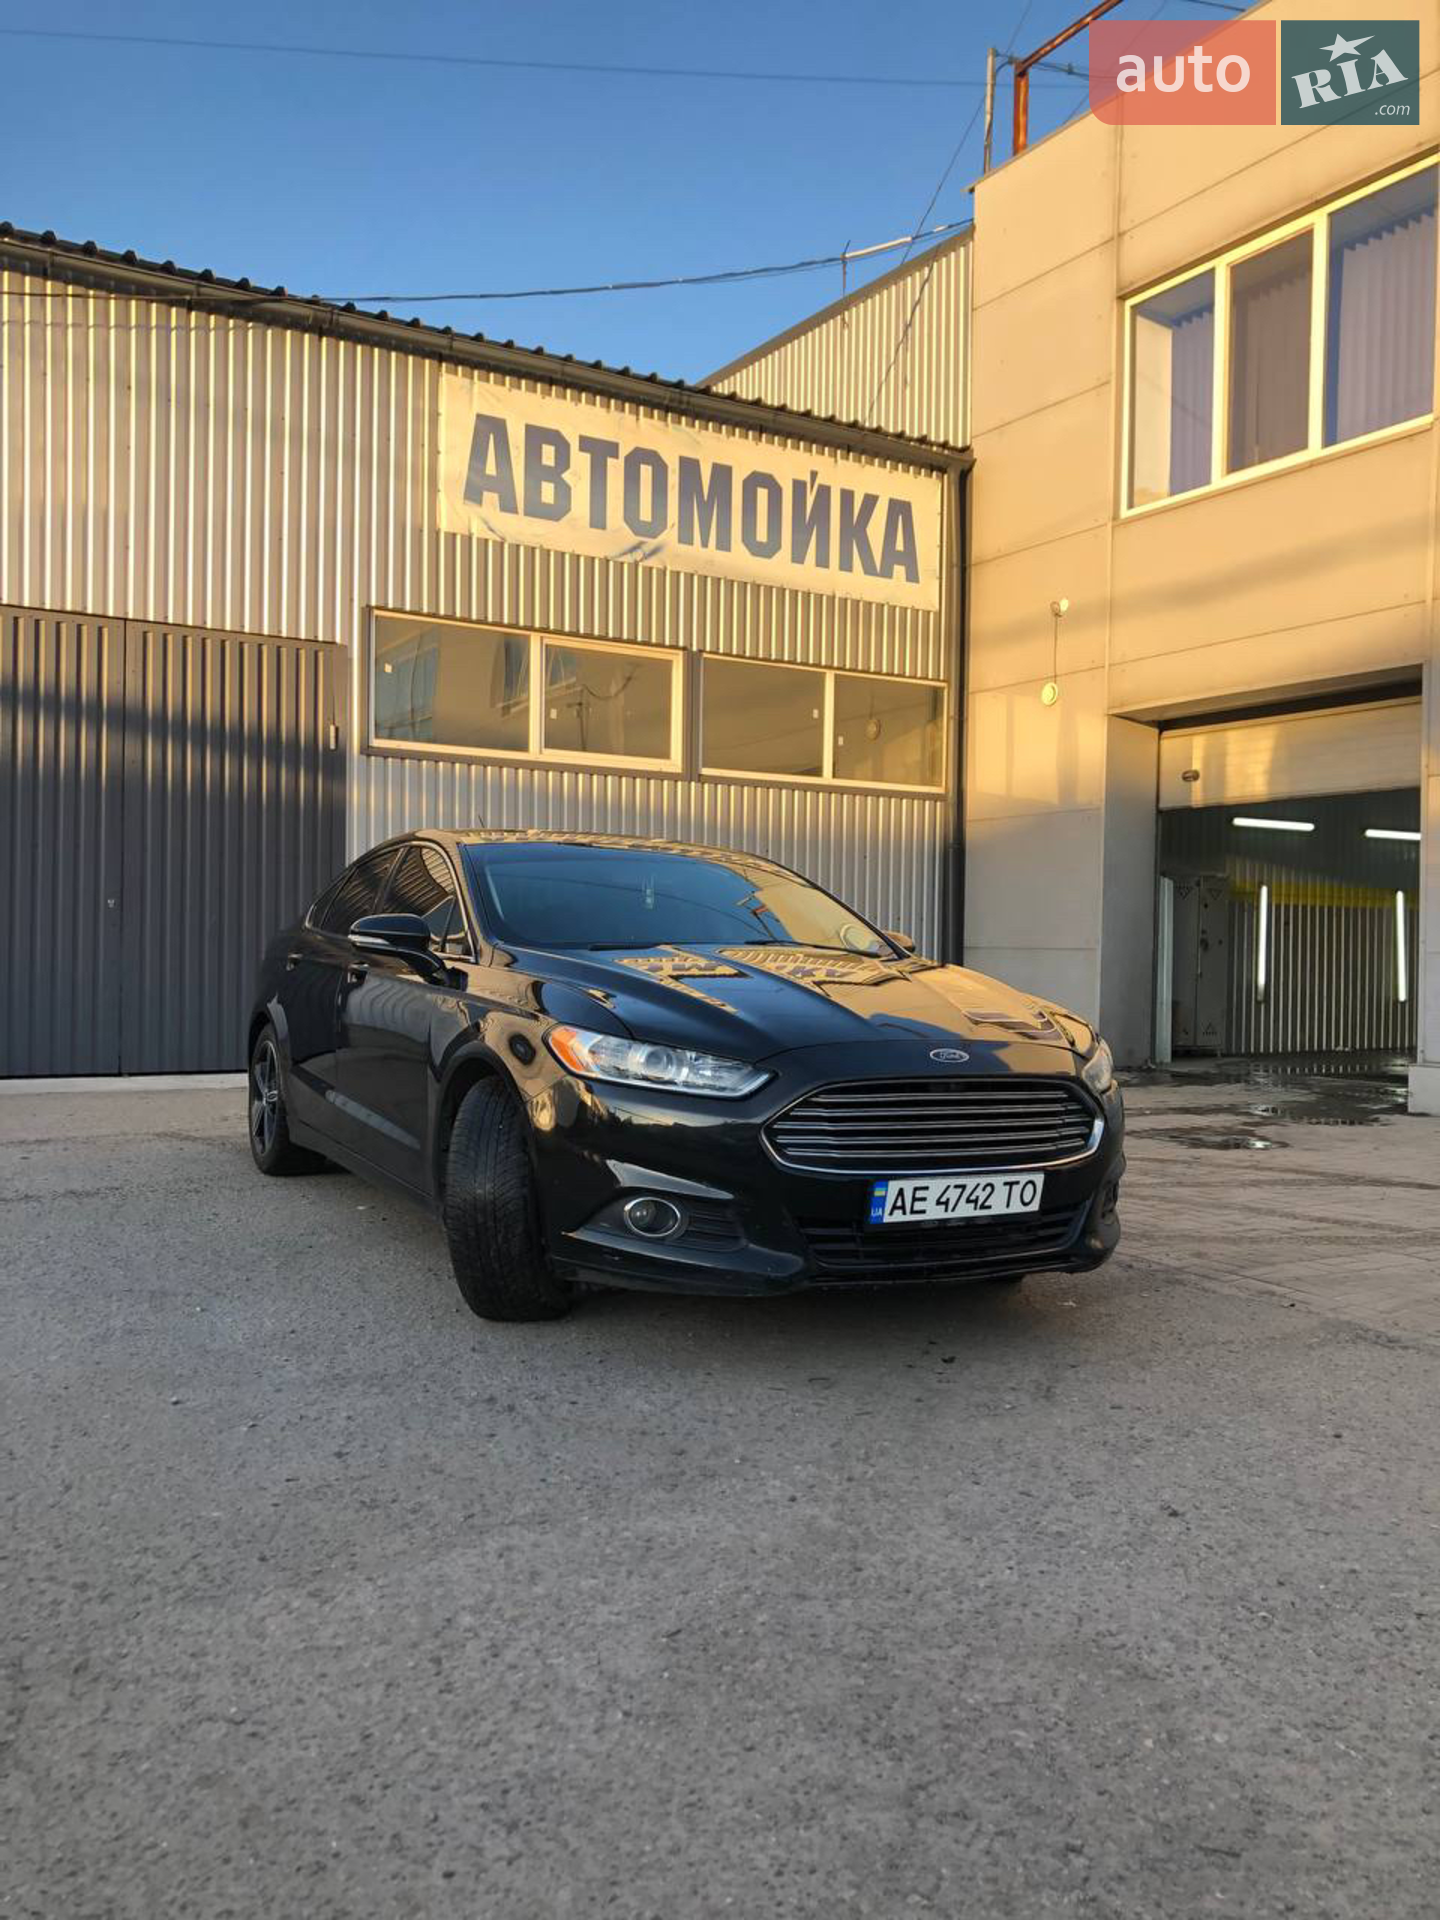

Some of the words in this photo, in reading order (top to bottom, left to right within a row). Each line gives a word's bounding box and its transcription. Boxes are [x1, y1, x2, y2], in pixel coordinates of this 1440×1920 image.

[463, 413, 920, 584] АВТОМОЙКА
[888, 1186, 929, 1216] AE
[935, 1183, 995, 1213] 4742
[1003, 1180, 1037, 1208] TO
